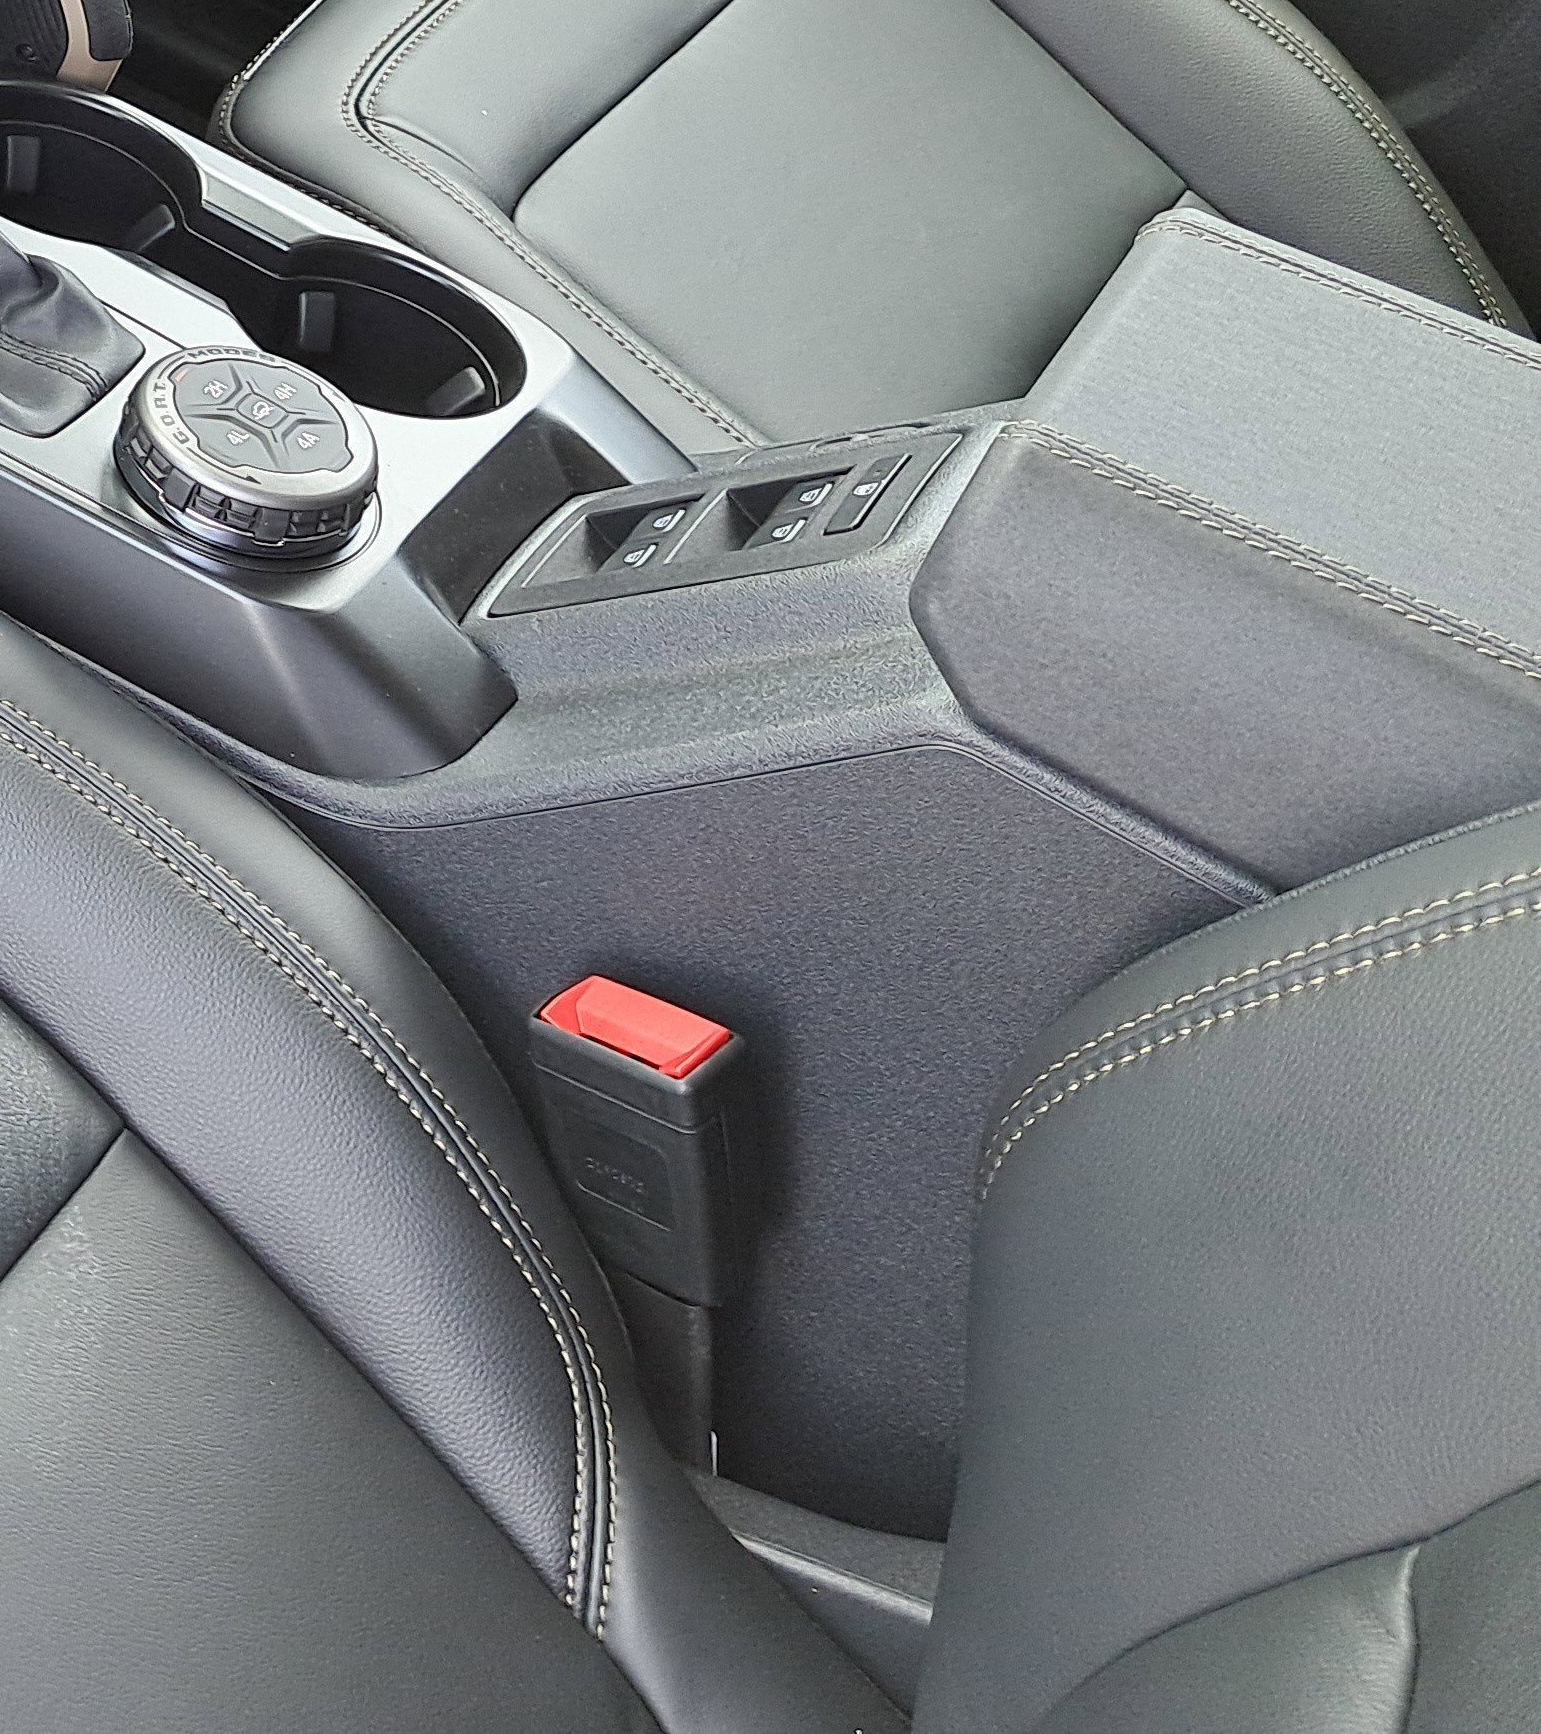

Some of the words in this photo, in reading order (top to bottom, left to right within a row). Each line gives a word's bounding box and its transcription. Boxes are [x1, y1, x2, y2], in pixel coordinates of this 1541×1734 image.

[187, 348, 276, 363] MODES
[203, 379, 229, 398] 2H
[274, 381, 298, 401] 4H
[226, 429, 251, 447] 4L
[296, 431, 320, 451] 4A
